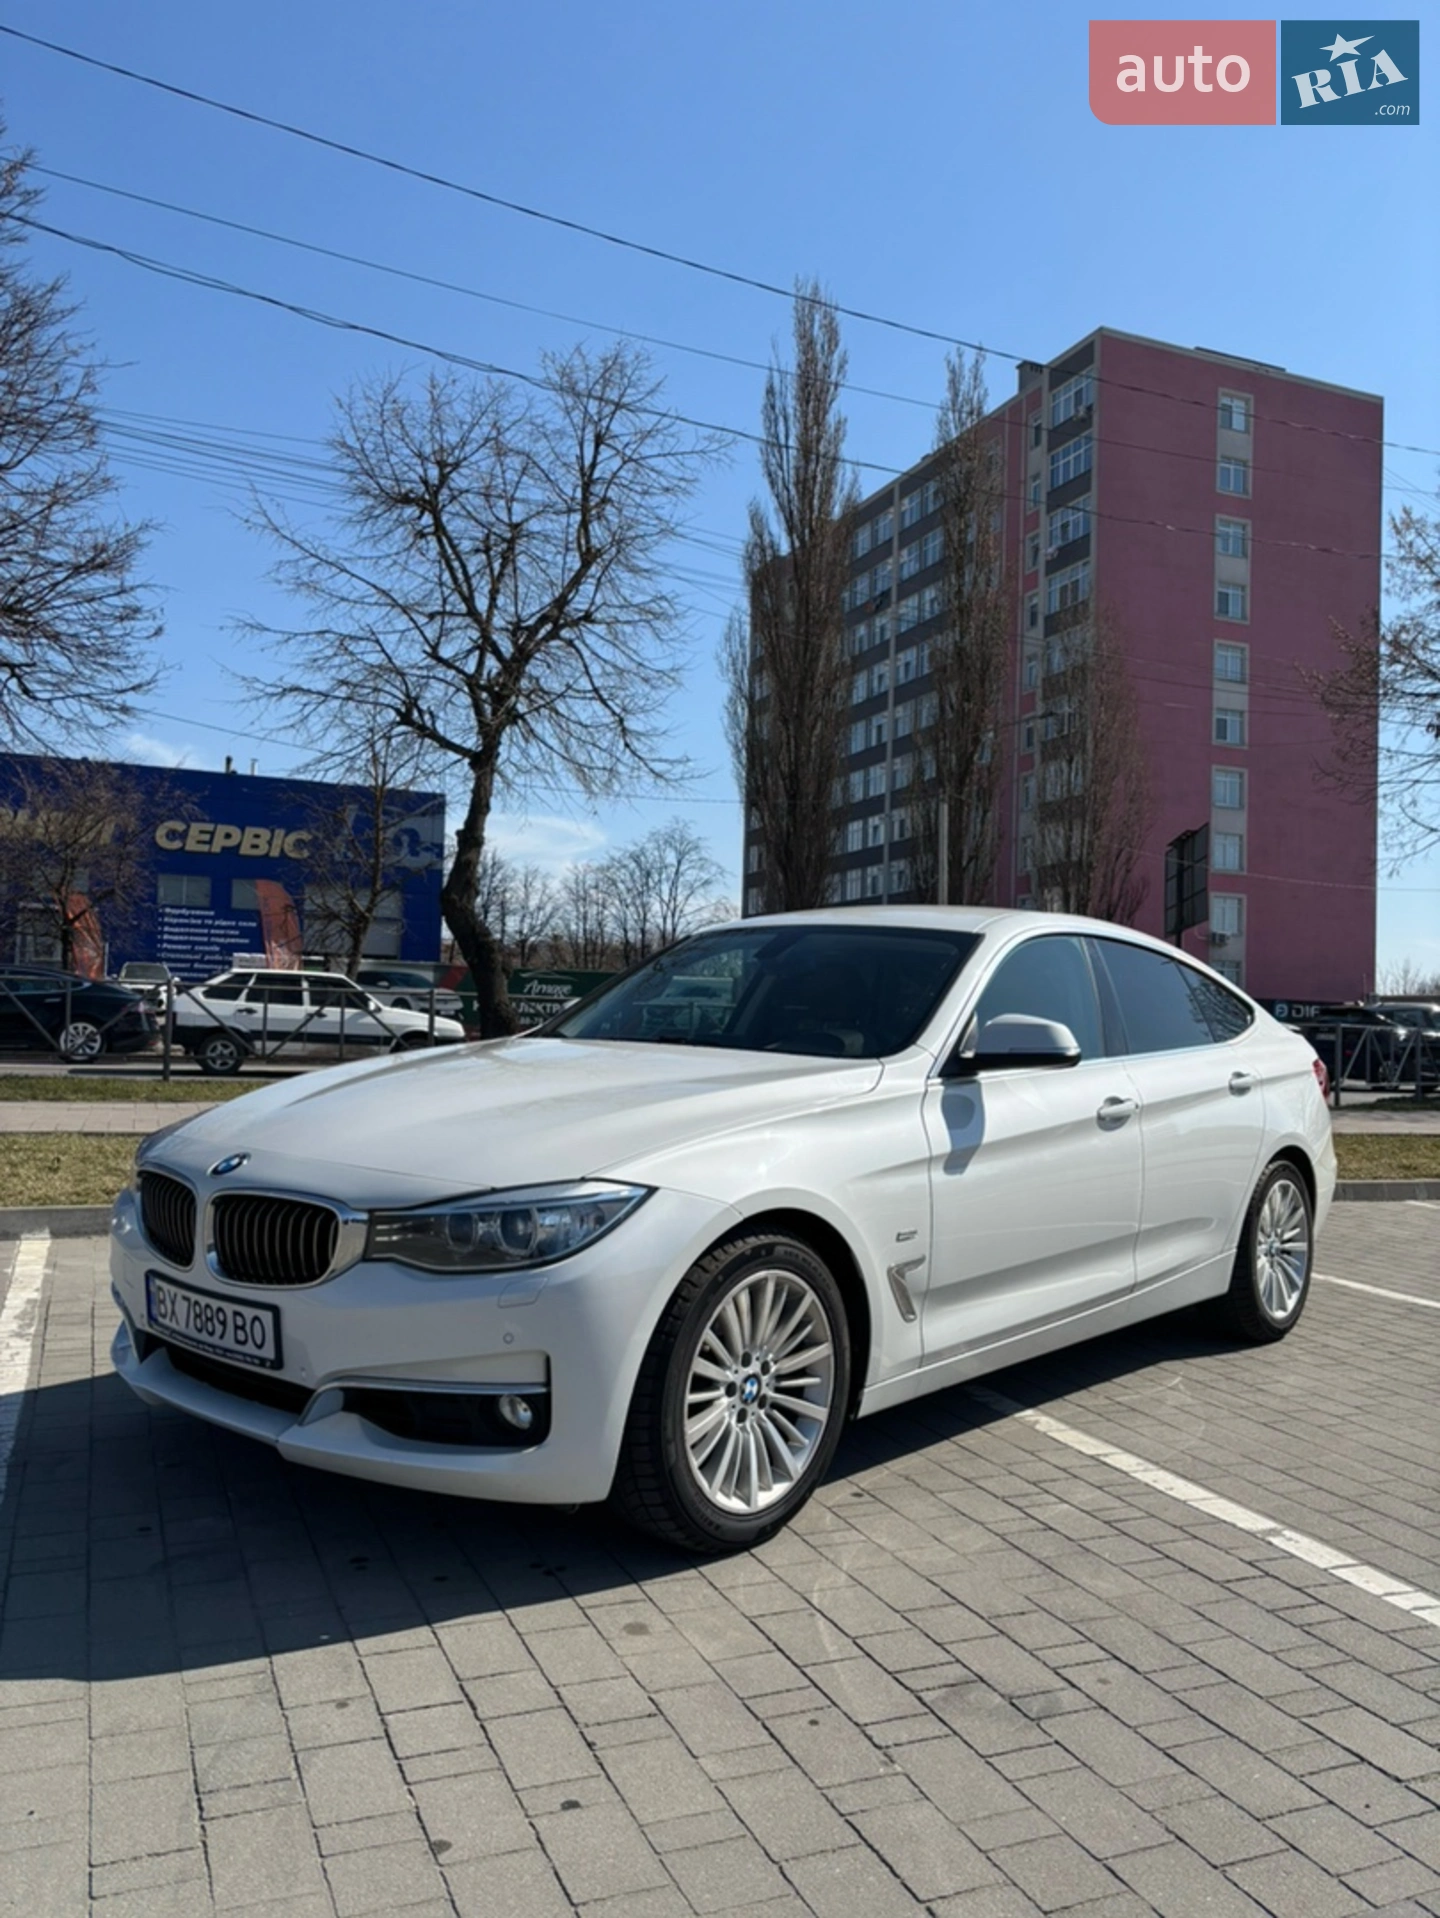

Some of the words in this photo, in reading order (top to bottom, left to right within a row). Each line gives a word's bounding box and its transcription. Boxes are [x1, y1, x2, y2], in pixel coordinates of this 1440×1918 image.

[155, 820, 312, 859] СЕРВІС
[157, 1285, 180, 1327] BX
[181, 1295, 228, 1340] 7889
[232, 1310, 266, 1350] BO
